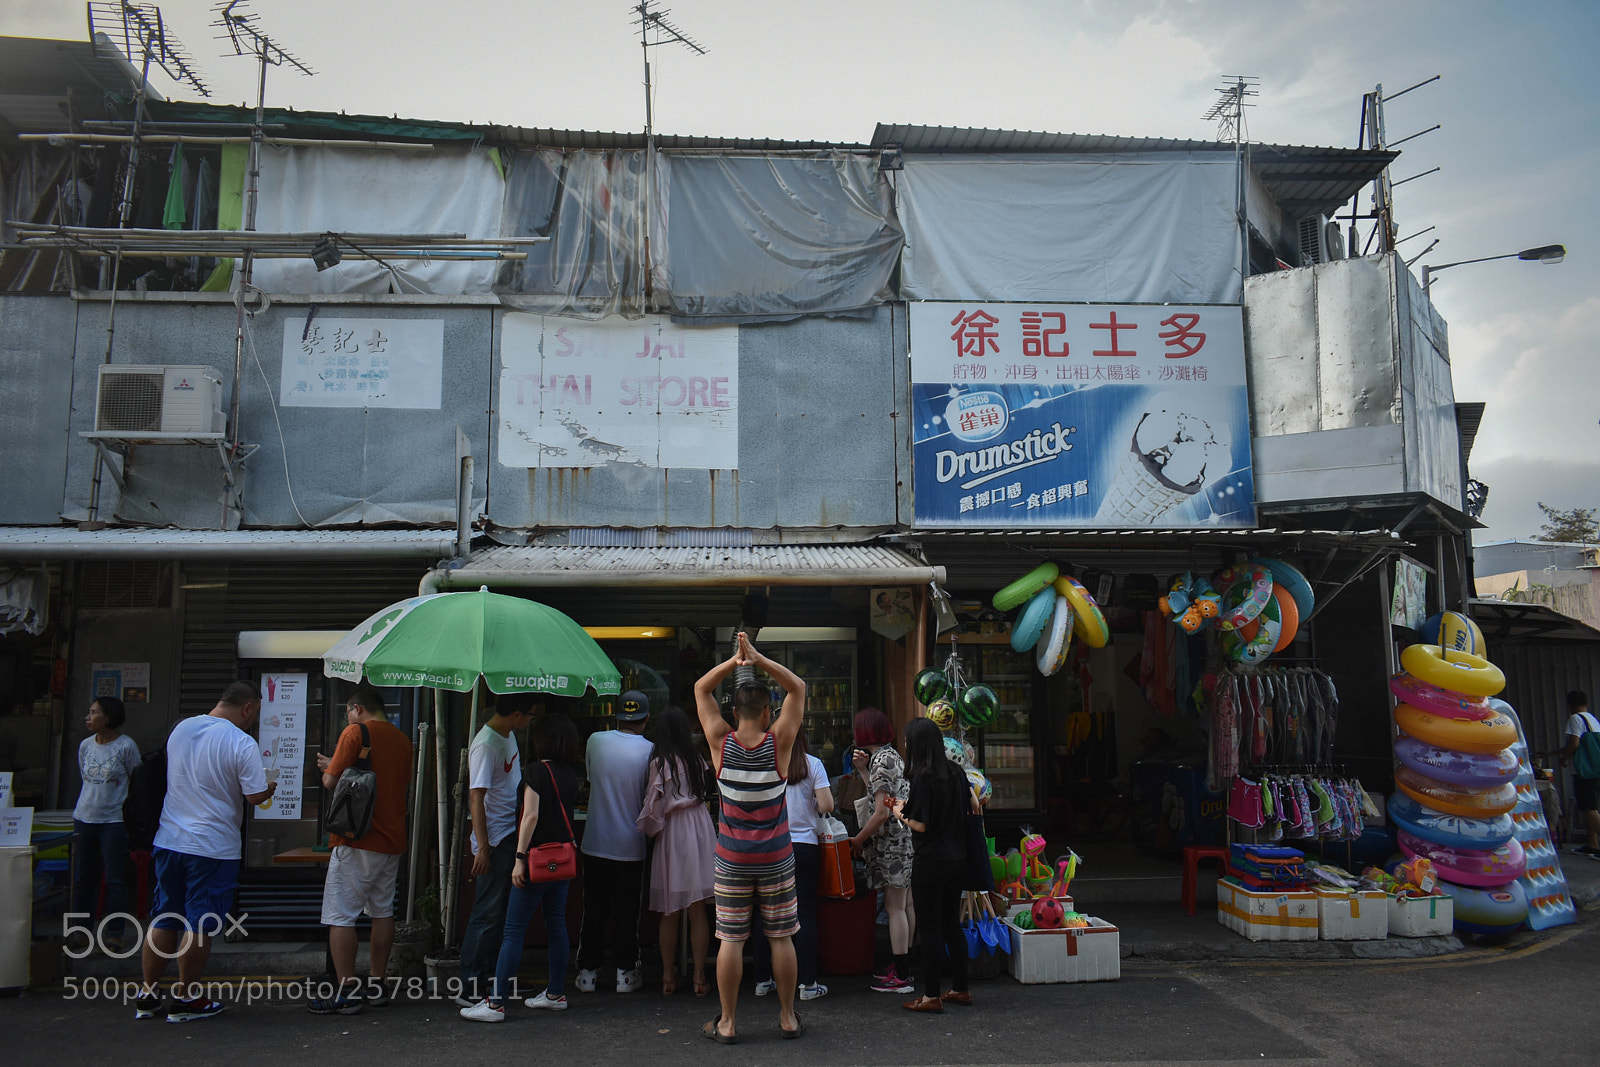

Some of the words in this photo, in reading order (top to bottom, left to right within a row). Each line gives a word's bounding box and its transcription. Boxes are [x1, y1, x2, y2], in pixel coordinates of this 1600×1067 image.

[635, 328, 685, 358] JAI
[950, 309, 1207, 359] 徐記士多
[509, 374, 592, 405] THAI
[620, 376, 730, 407] STORE
[958, 407, 1000, 432] 雀巢
[935, 422, 1073, 483] Drumstick
[959, 481, 1022, 514] 震撼口感
[383, 671, 464, 687] www.swapit.la
[505, 674, 556, 691] swapit
[273, 795, 301, 803] Pineapple
